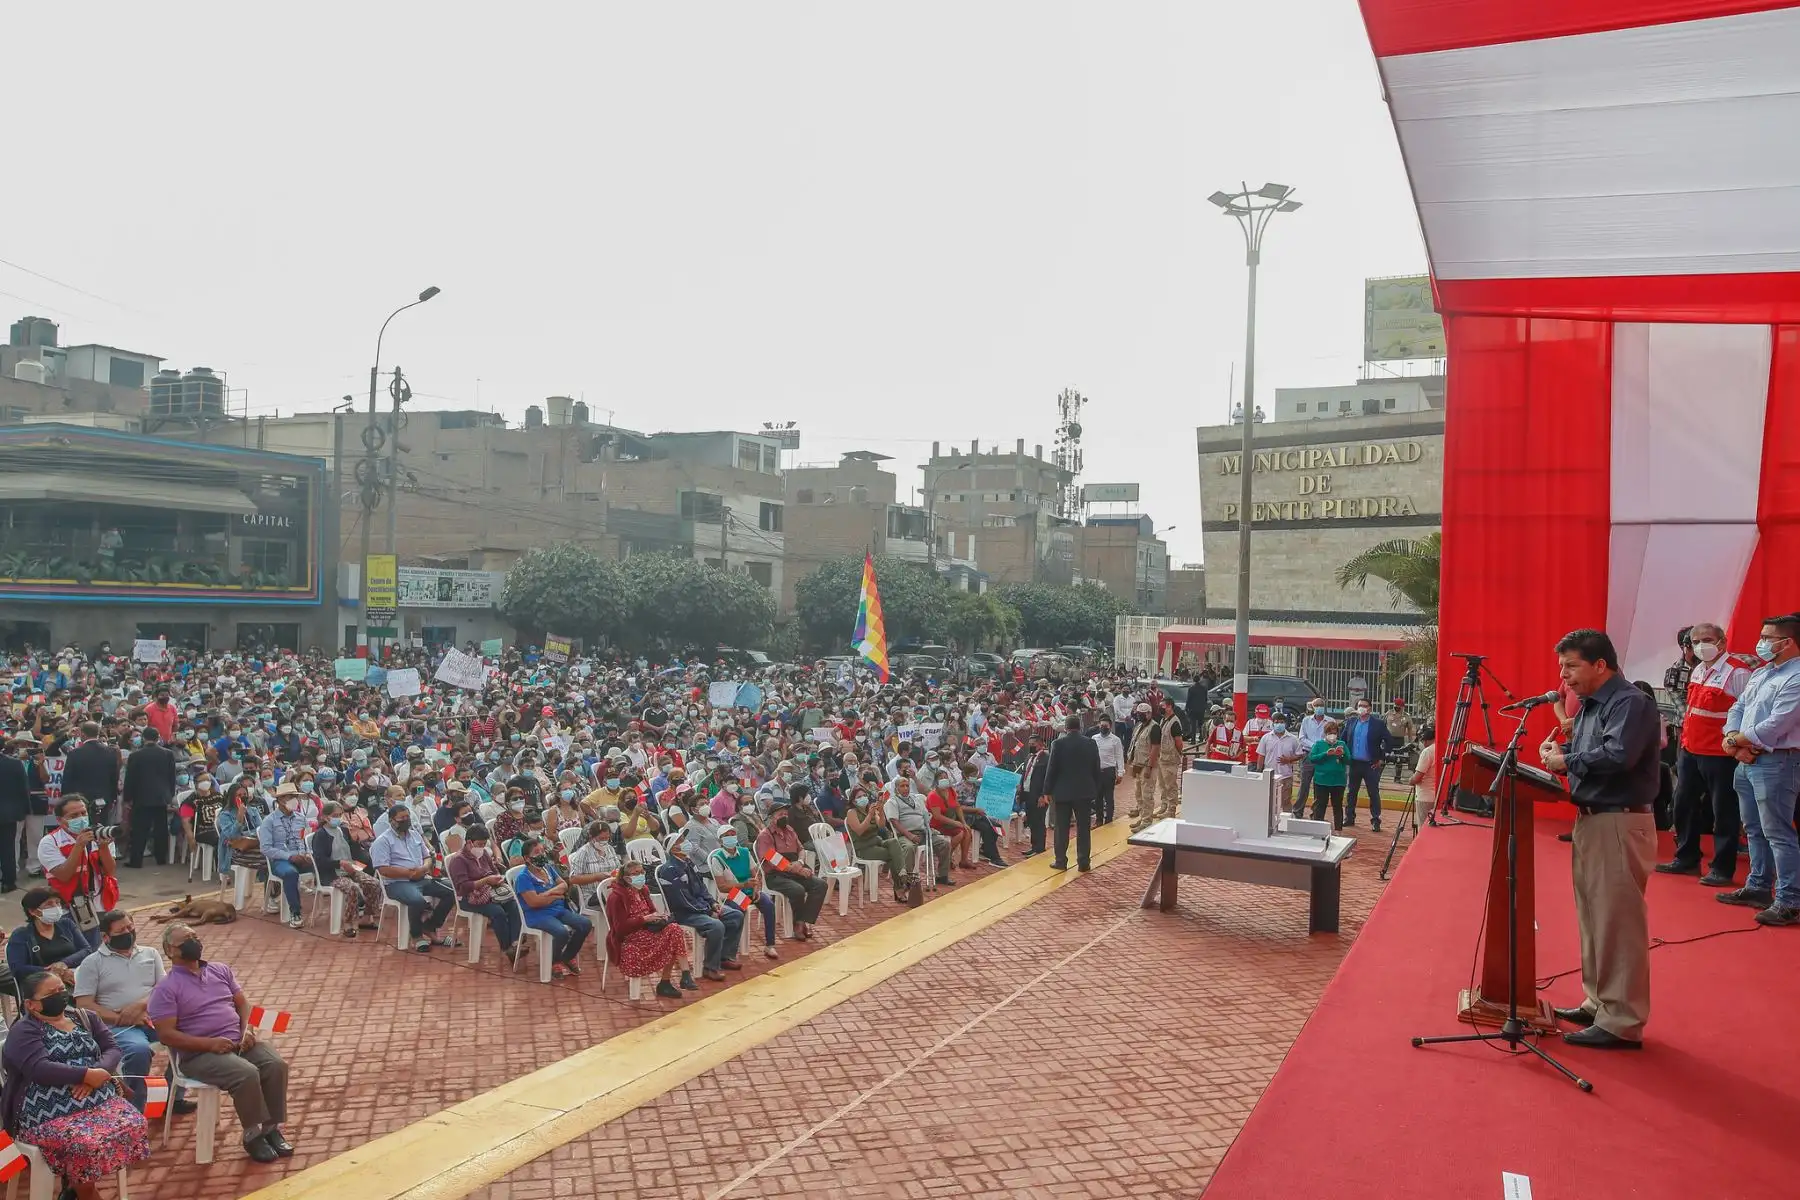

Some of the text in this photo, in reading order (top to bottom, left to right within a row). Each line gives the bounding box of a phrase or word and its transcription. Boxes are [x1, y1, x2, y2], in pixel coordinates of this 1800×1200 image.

[1220, 441, 1423, 476] MNICIPALIDAD
[1297, 474, 1332, 496] DE
[243, 513, 290, 528] CAPITAL
[1223, 495, 1418, 523] PENTE PIEDRA
